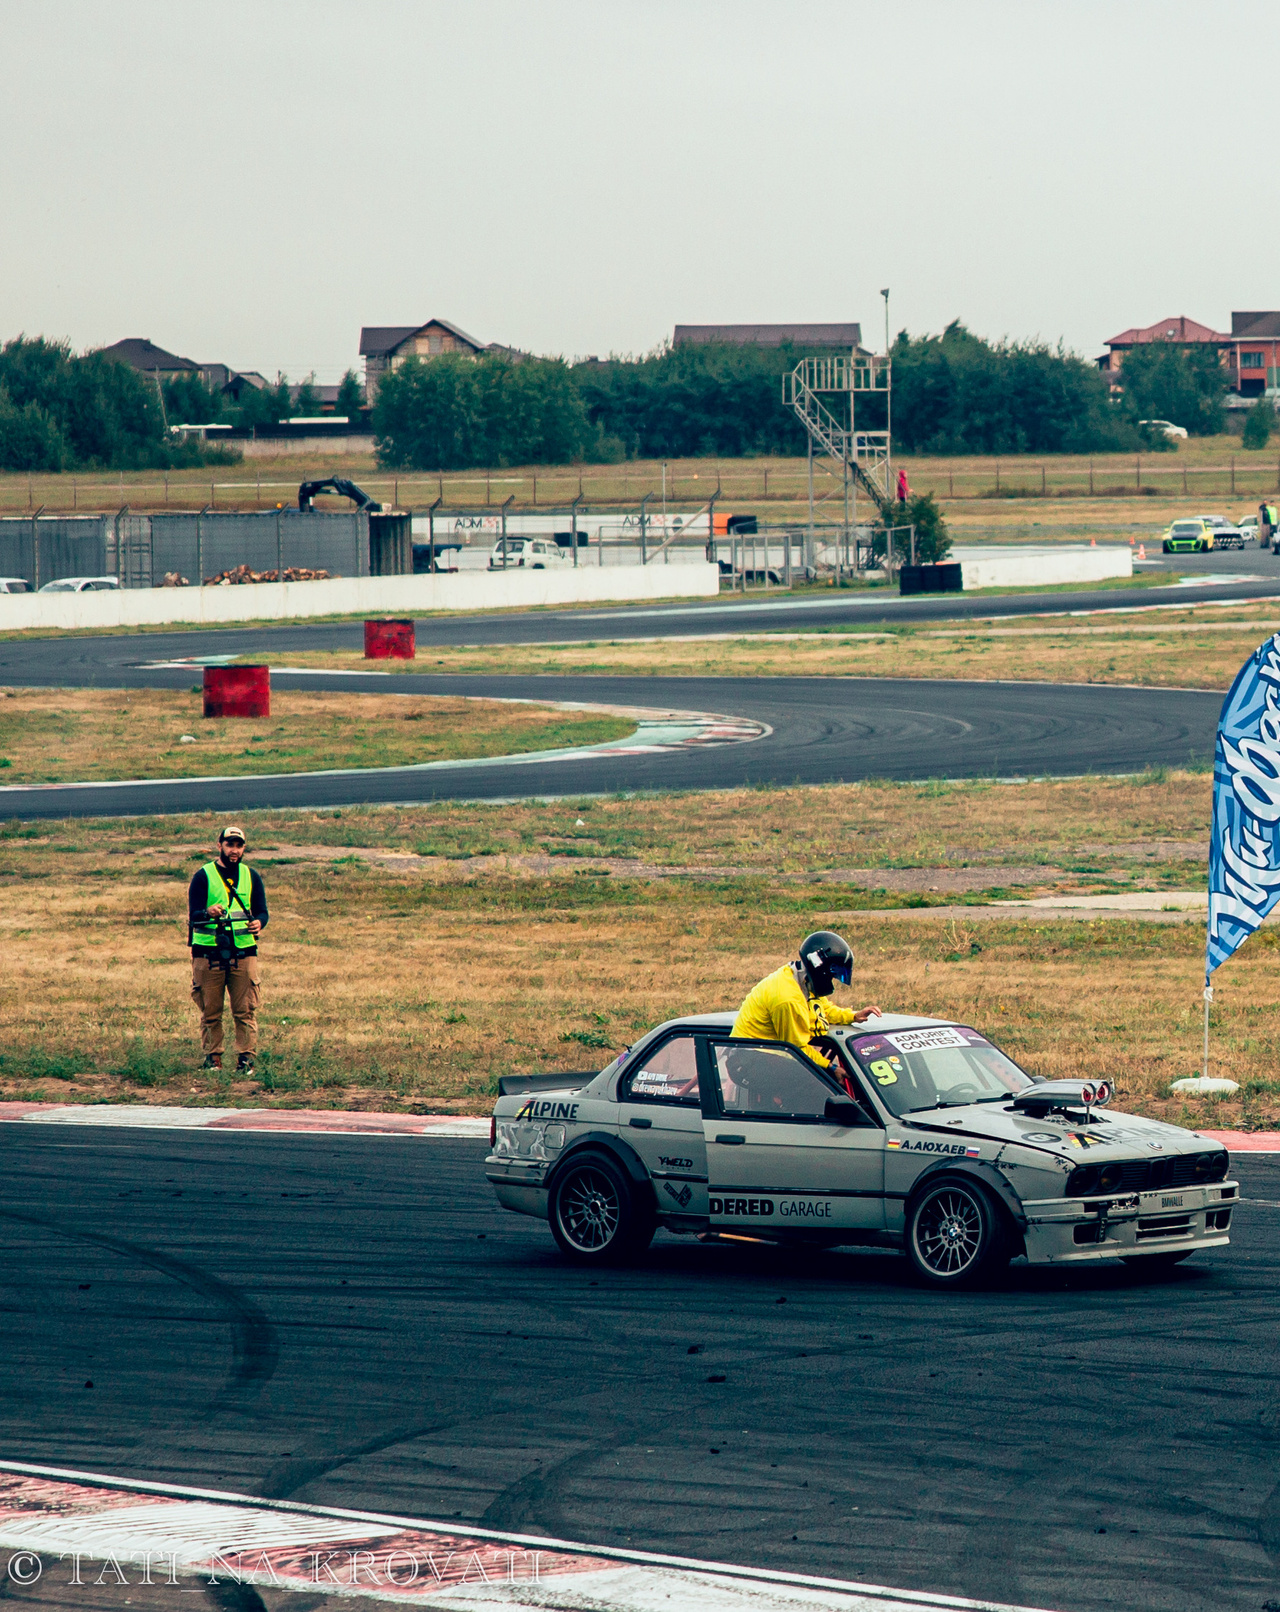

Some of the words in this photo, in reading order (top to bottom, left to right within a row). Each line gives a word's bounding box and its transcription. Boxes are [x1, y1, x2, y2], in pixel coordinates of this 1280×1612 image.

[455, 517, 483, 529] ADM
[894, 1033, 922, 1044] ADM
[922, 1029, 954, 1039] DRIFT
[901, 1036, 961, 1050] CONTEST
[869, 1059, 898, 1086] 9
[515, 1099, 580, 1122] ALPINE
[901, 1140, 966, 1155] А.АЮХАЕВ
[779, 1200, 832, 1217] GARAGE
